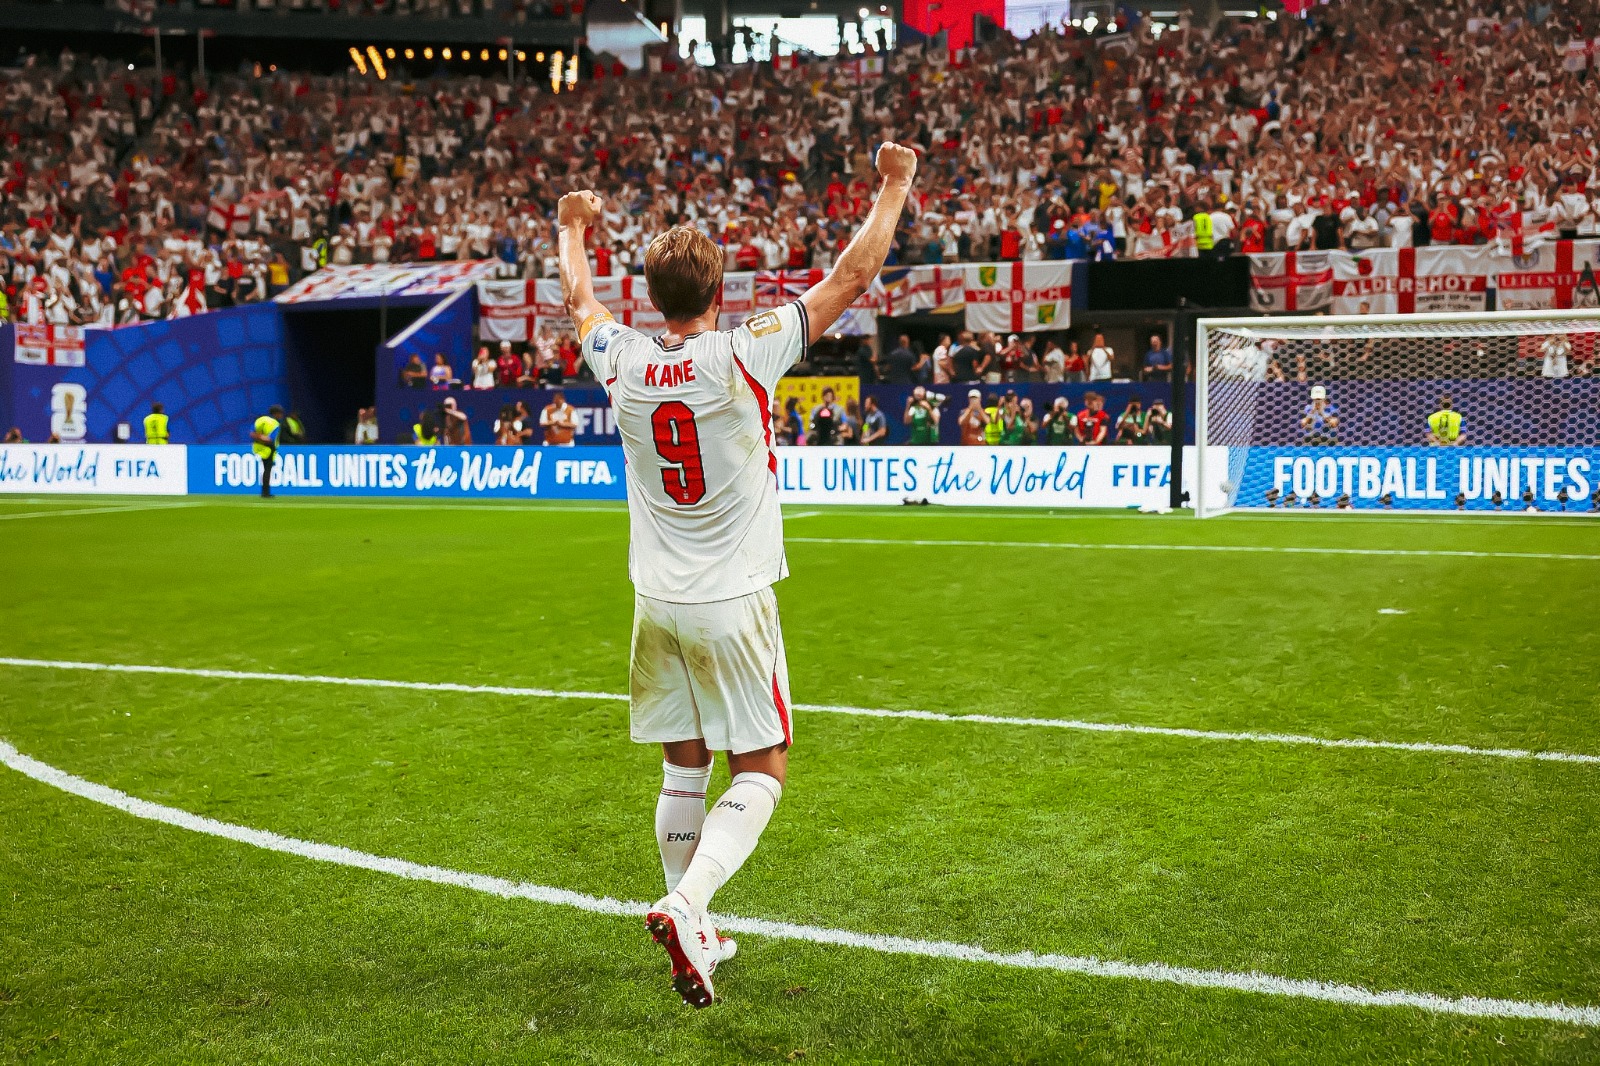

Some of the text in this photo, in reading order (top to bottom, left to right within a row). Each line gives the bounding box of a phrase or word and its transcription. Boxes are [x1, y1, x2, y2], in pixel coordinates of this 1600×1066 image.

[1342, 274, 1476, 297] ALDERSHOT
[644, 358, 696, 388] KANE
[33, 450, 99, 486] World
[116, 459, 159, 478] FIFA
[651, 400, 706, 505] 9
[329, 453, 407, 488] UNITES
[411, 448, 457, 491] the
[460, 449, 542, 495] World
[555, 460, 613, 485] FIFA
[823, 458, 918, 492] UNITES
[927, 452, 981, 495] the
[990, 452, 1089, 499] World
[1274, 456, 1591, 501] FOOTBALL UNITES
[717, 800, 747, 812] ENG
[666, 831, 696, 842] ENG
